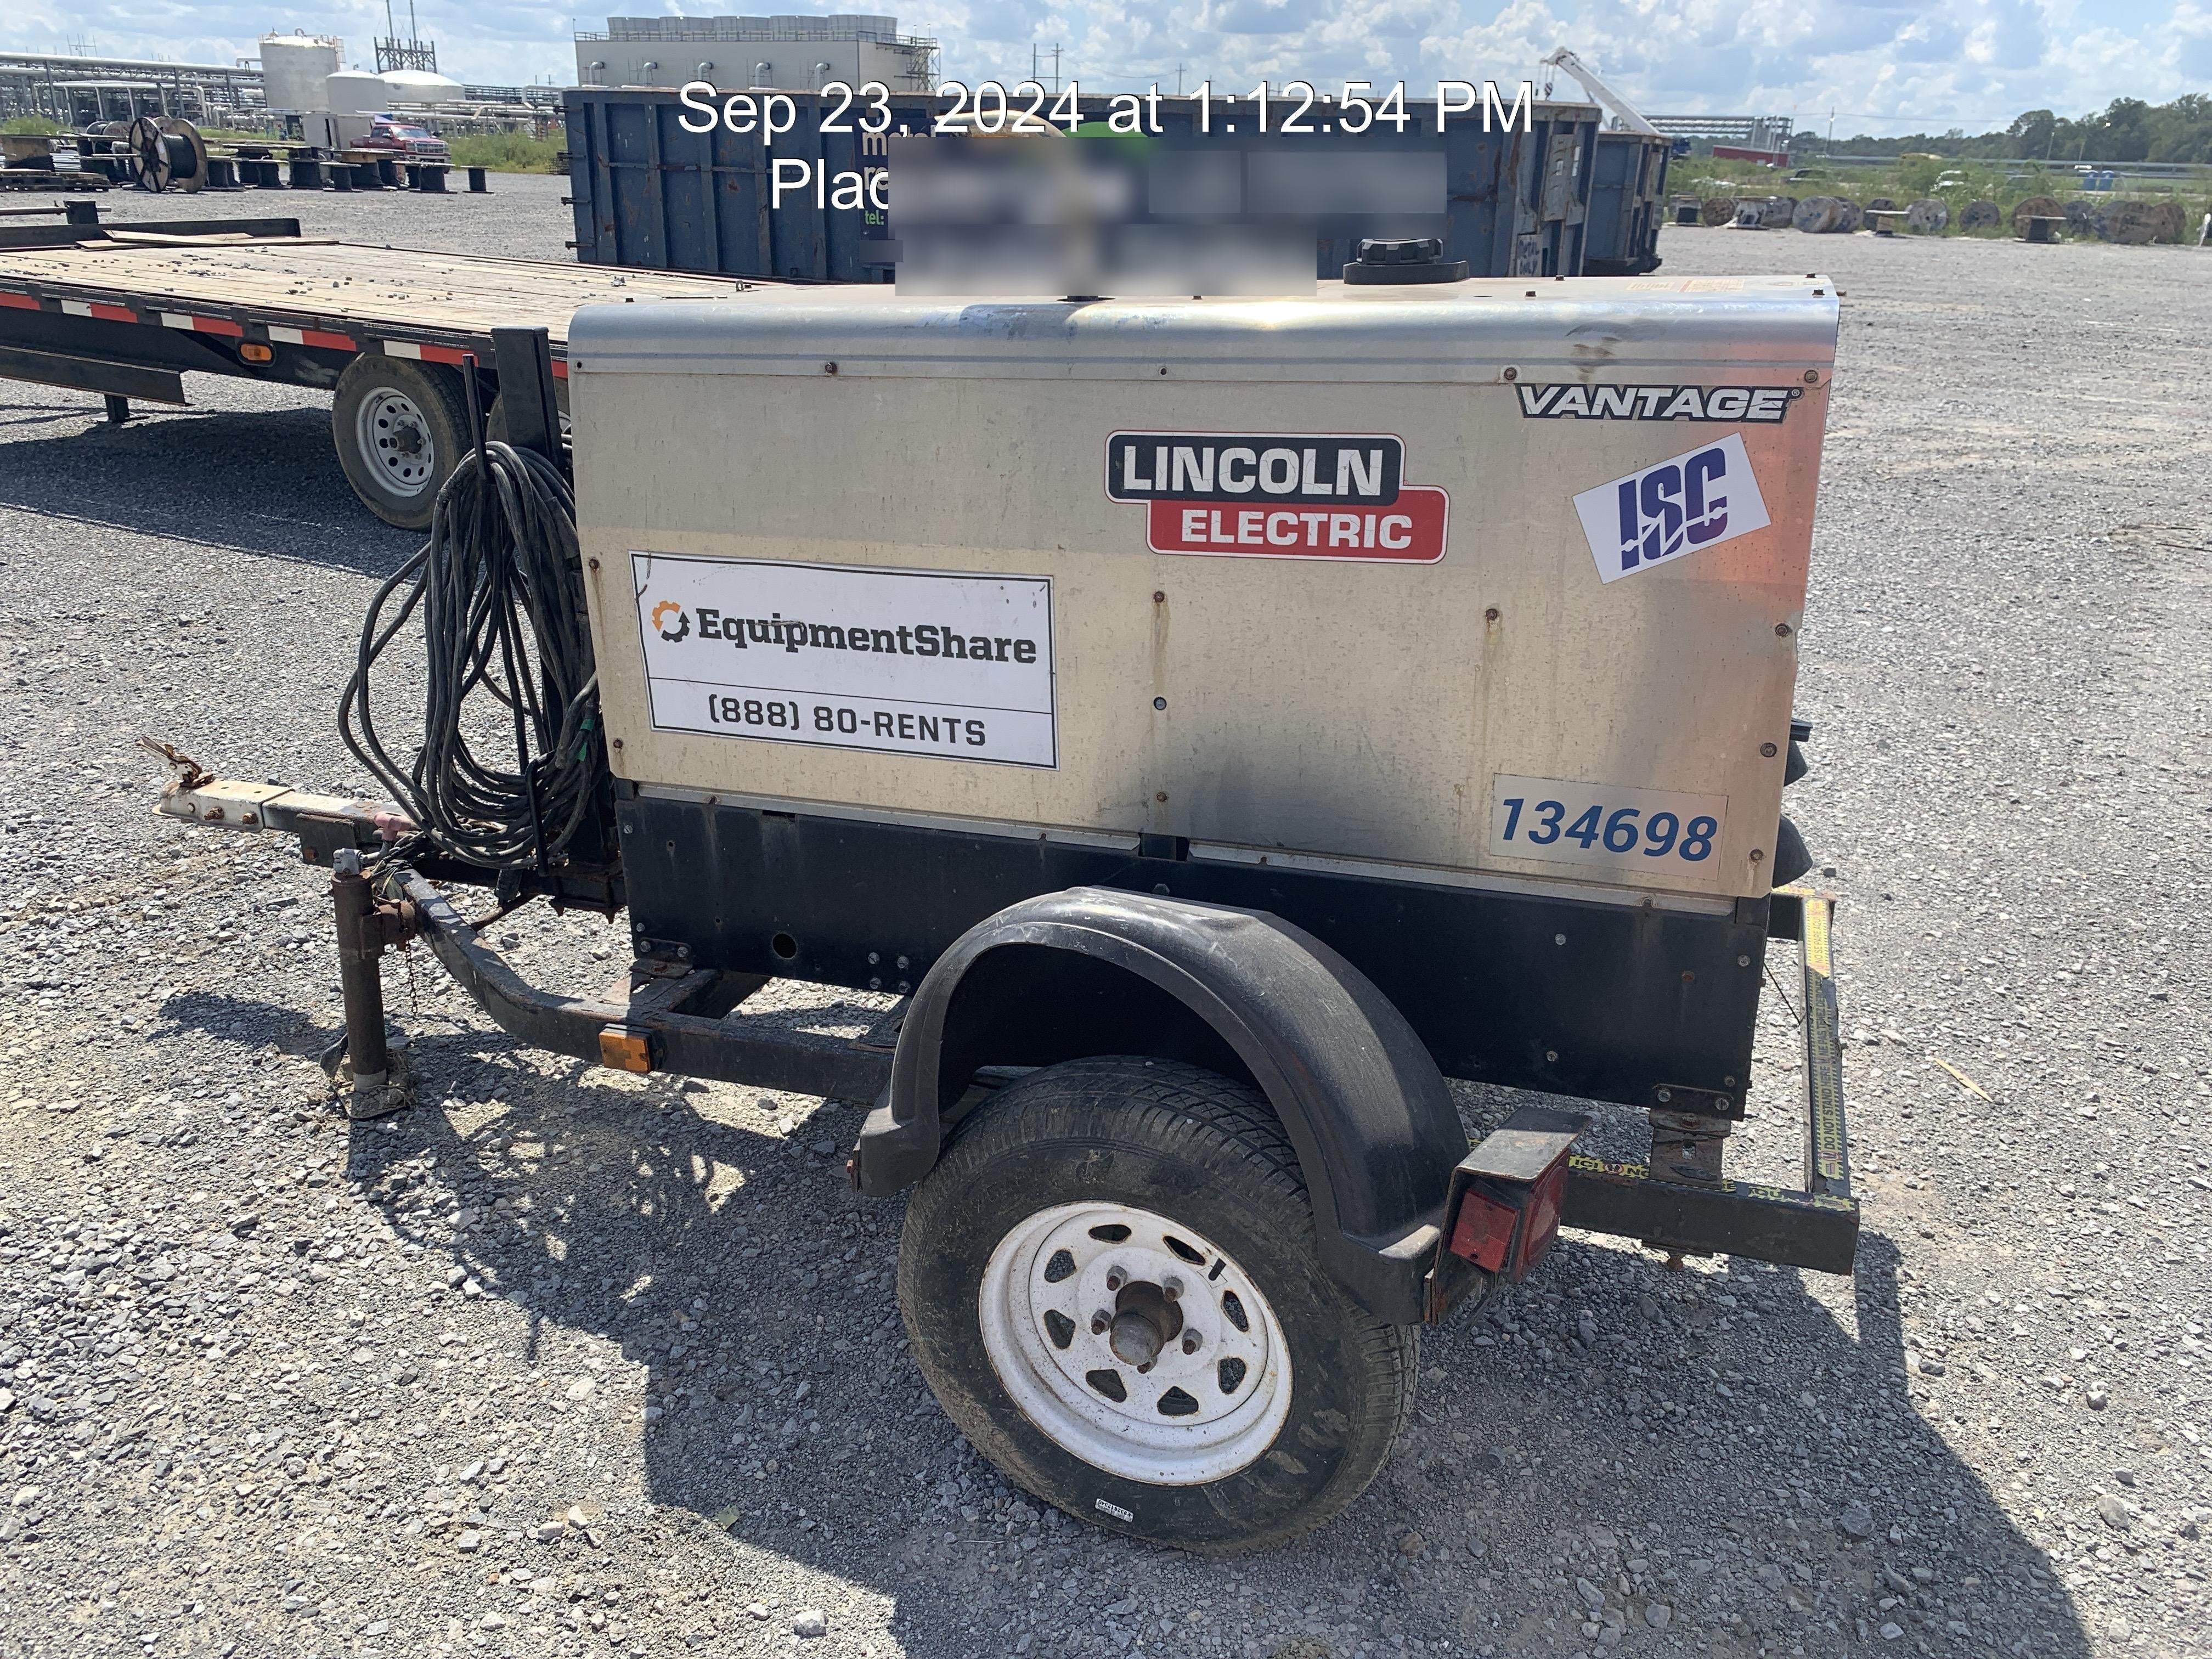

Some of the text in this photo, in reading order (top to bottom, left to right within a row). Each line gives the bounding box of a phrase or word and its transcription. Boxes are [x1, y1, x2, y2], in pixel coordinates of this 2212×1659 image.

[1123, 445, 1383, 496] LINCOLN
[1181, 509, 1412, 549] ELECTRIC
[1618, 447, 1728, 571] ISC
[696, 607, 1036, 664] EquipmentShare
[709, 694, 986, 746] (888) 80-RENTS
[1502, 798, 1718, 861] 134698
[1820, 1065, 1836, 1150] DO NOT STAND HERE
